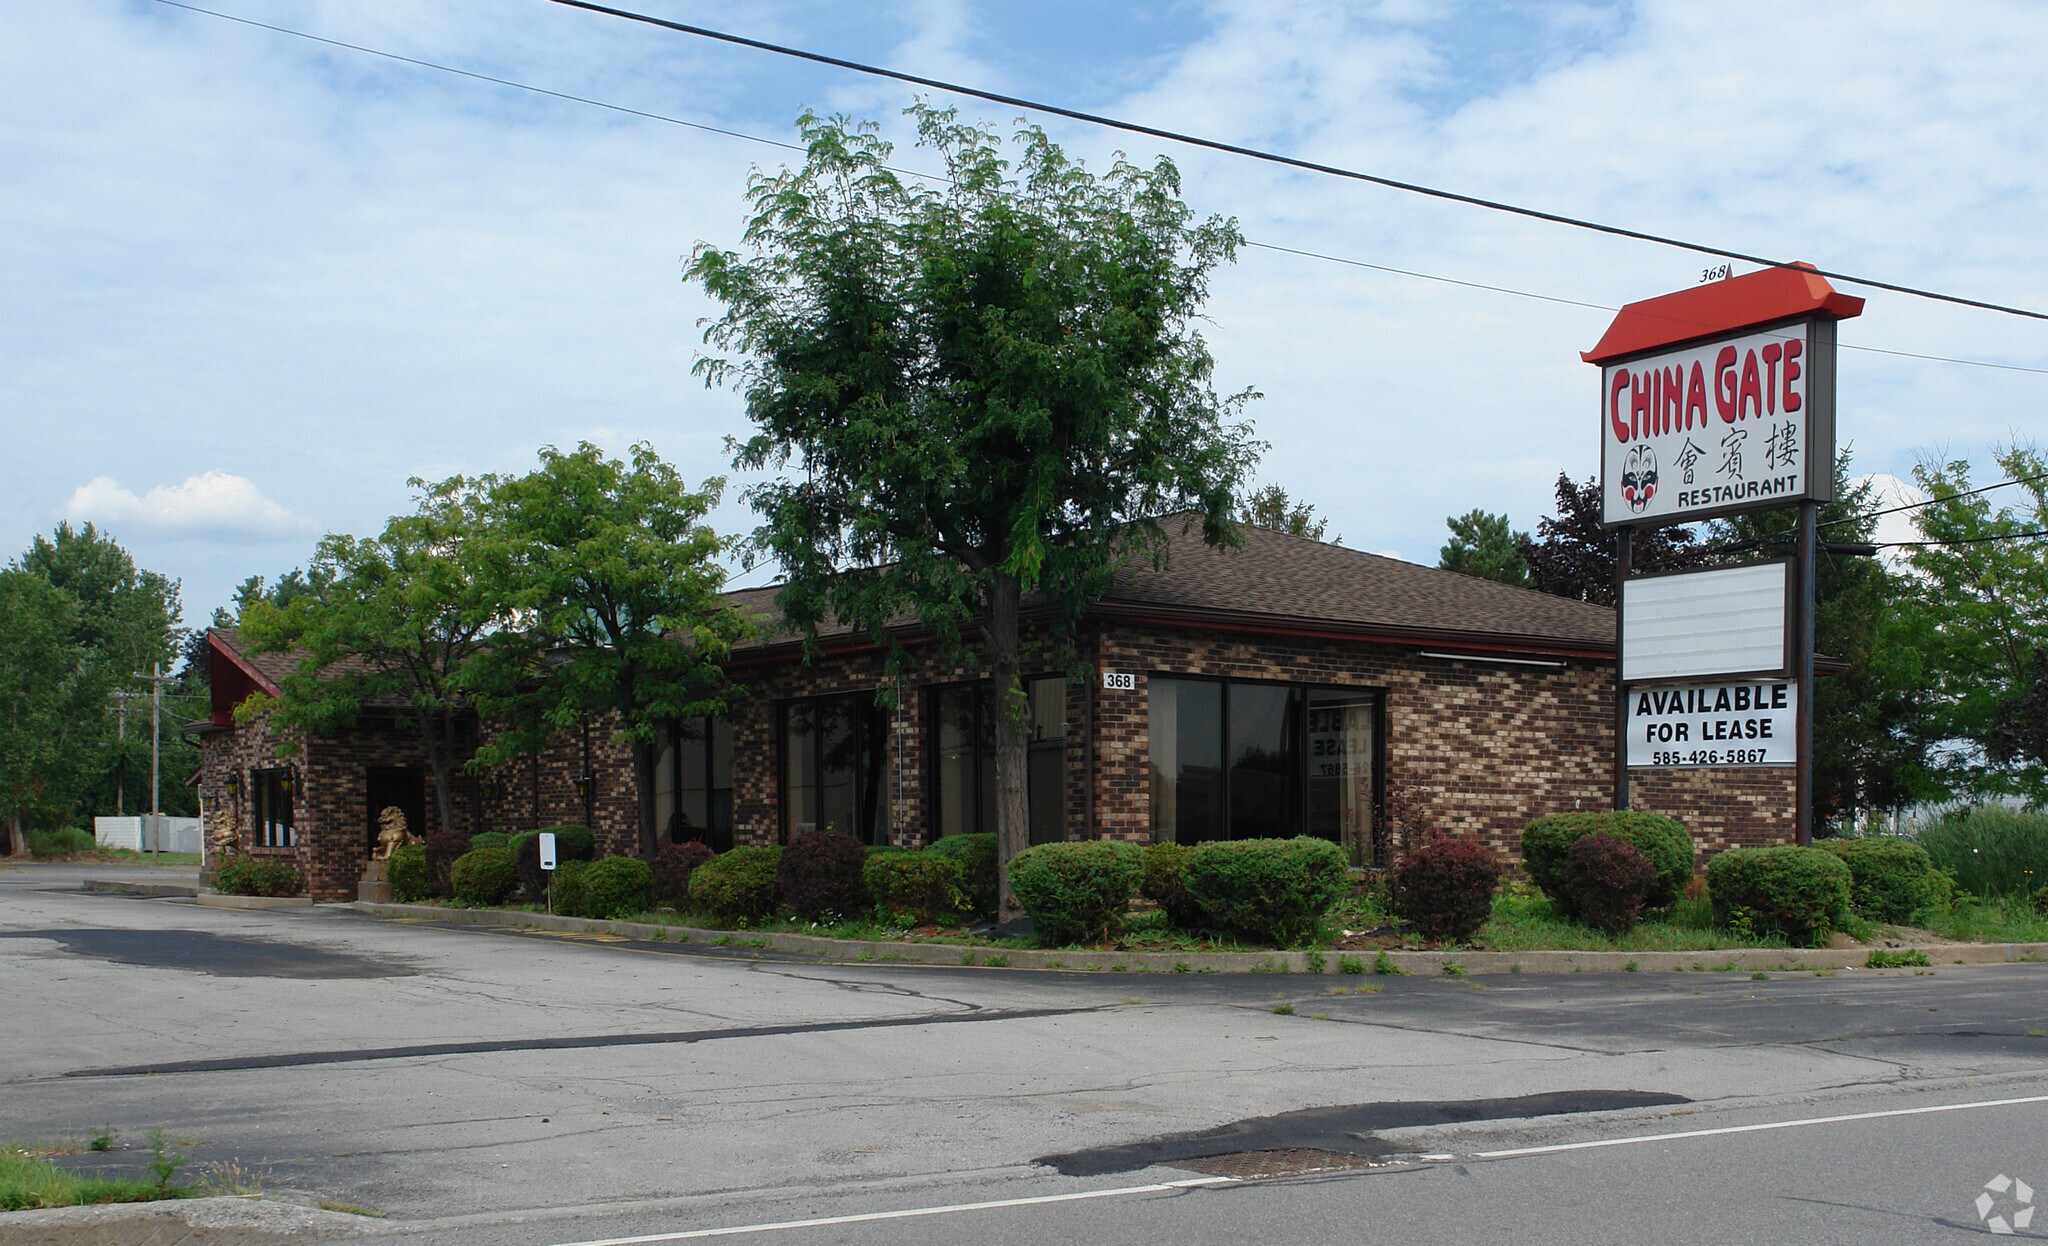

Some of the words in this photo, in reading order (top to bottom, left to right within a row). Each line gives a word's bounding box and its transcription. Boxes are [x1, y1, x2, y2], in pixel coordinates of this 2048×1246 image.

[1699, 264, 1726, 283] 368
[1610, 359, 1707, 443] CHINA
[1714, 338, 1802, 424] GATE
[1673, 420, 1800, 486] 會賓樓
[1678, 475, 1798, 507] RESTAURANT
[1107, 674, 1131, 688] 368
[1636, 684, 1788, 716] AVAILABLE
[1646, 722, 1689, 743] FOR
[1702, 718, 1773, 741] LEASE
[1653, 749, 1767, 765] 585-426-5867
